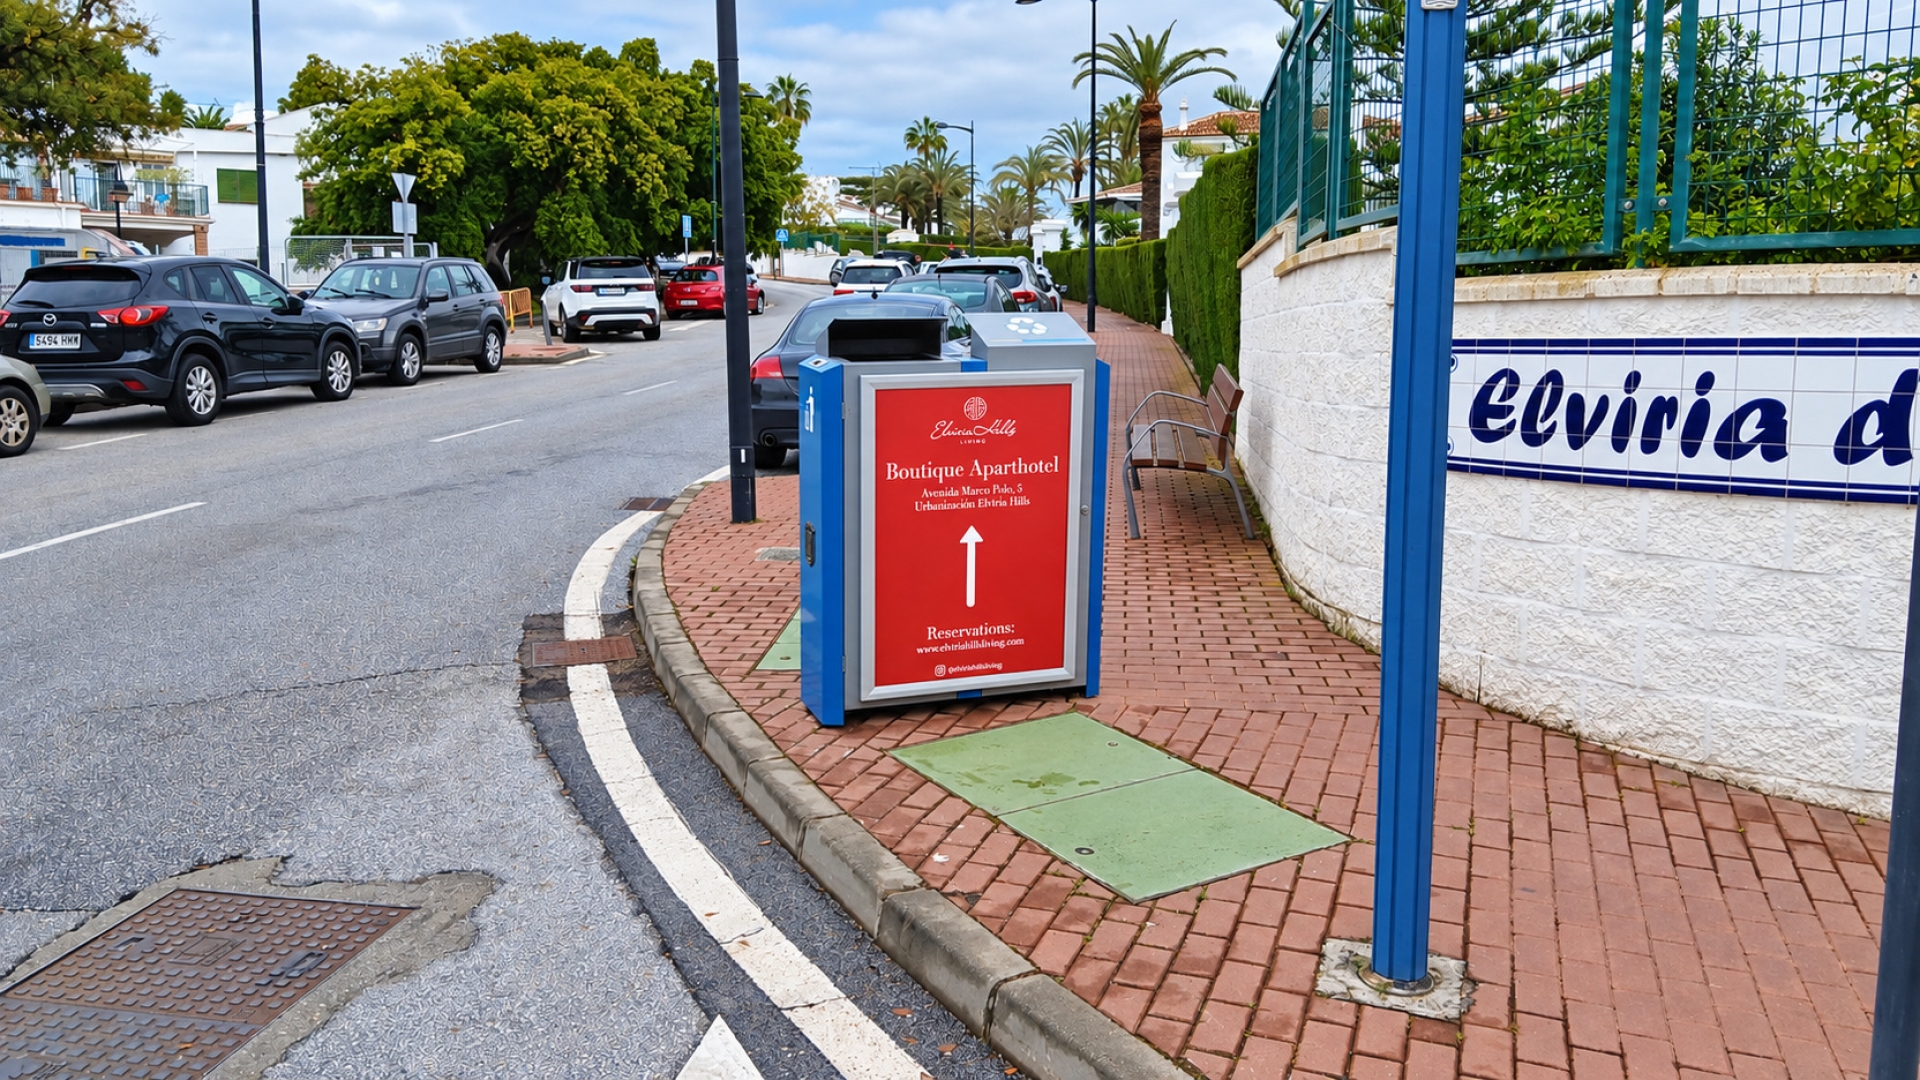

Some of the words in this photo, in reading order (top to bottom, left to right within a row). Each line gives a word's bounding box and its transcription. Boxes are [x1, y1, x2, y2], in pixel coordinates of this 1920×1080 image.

[1469, 367, 1789, 464] Elviria
[886, 461, 965, 484] Boutique
[969, 456, 1059, 481] Aparthotel
[921, 487, 959, 498] Avenida
[962, 486, 990, 496] Marco
[927, 622, 1015, 641] Reservations:
